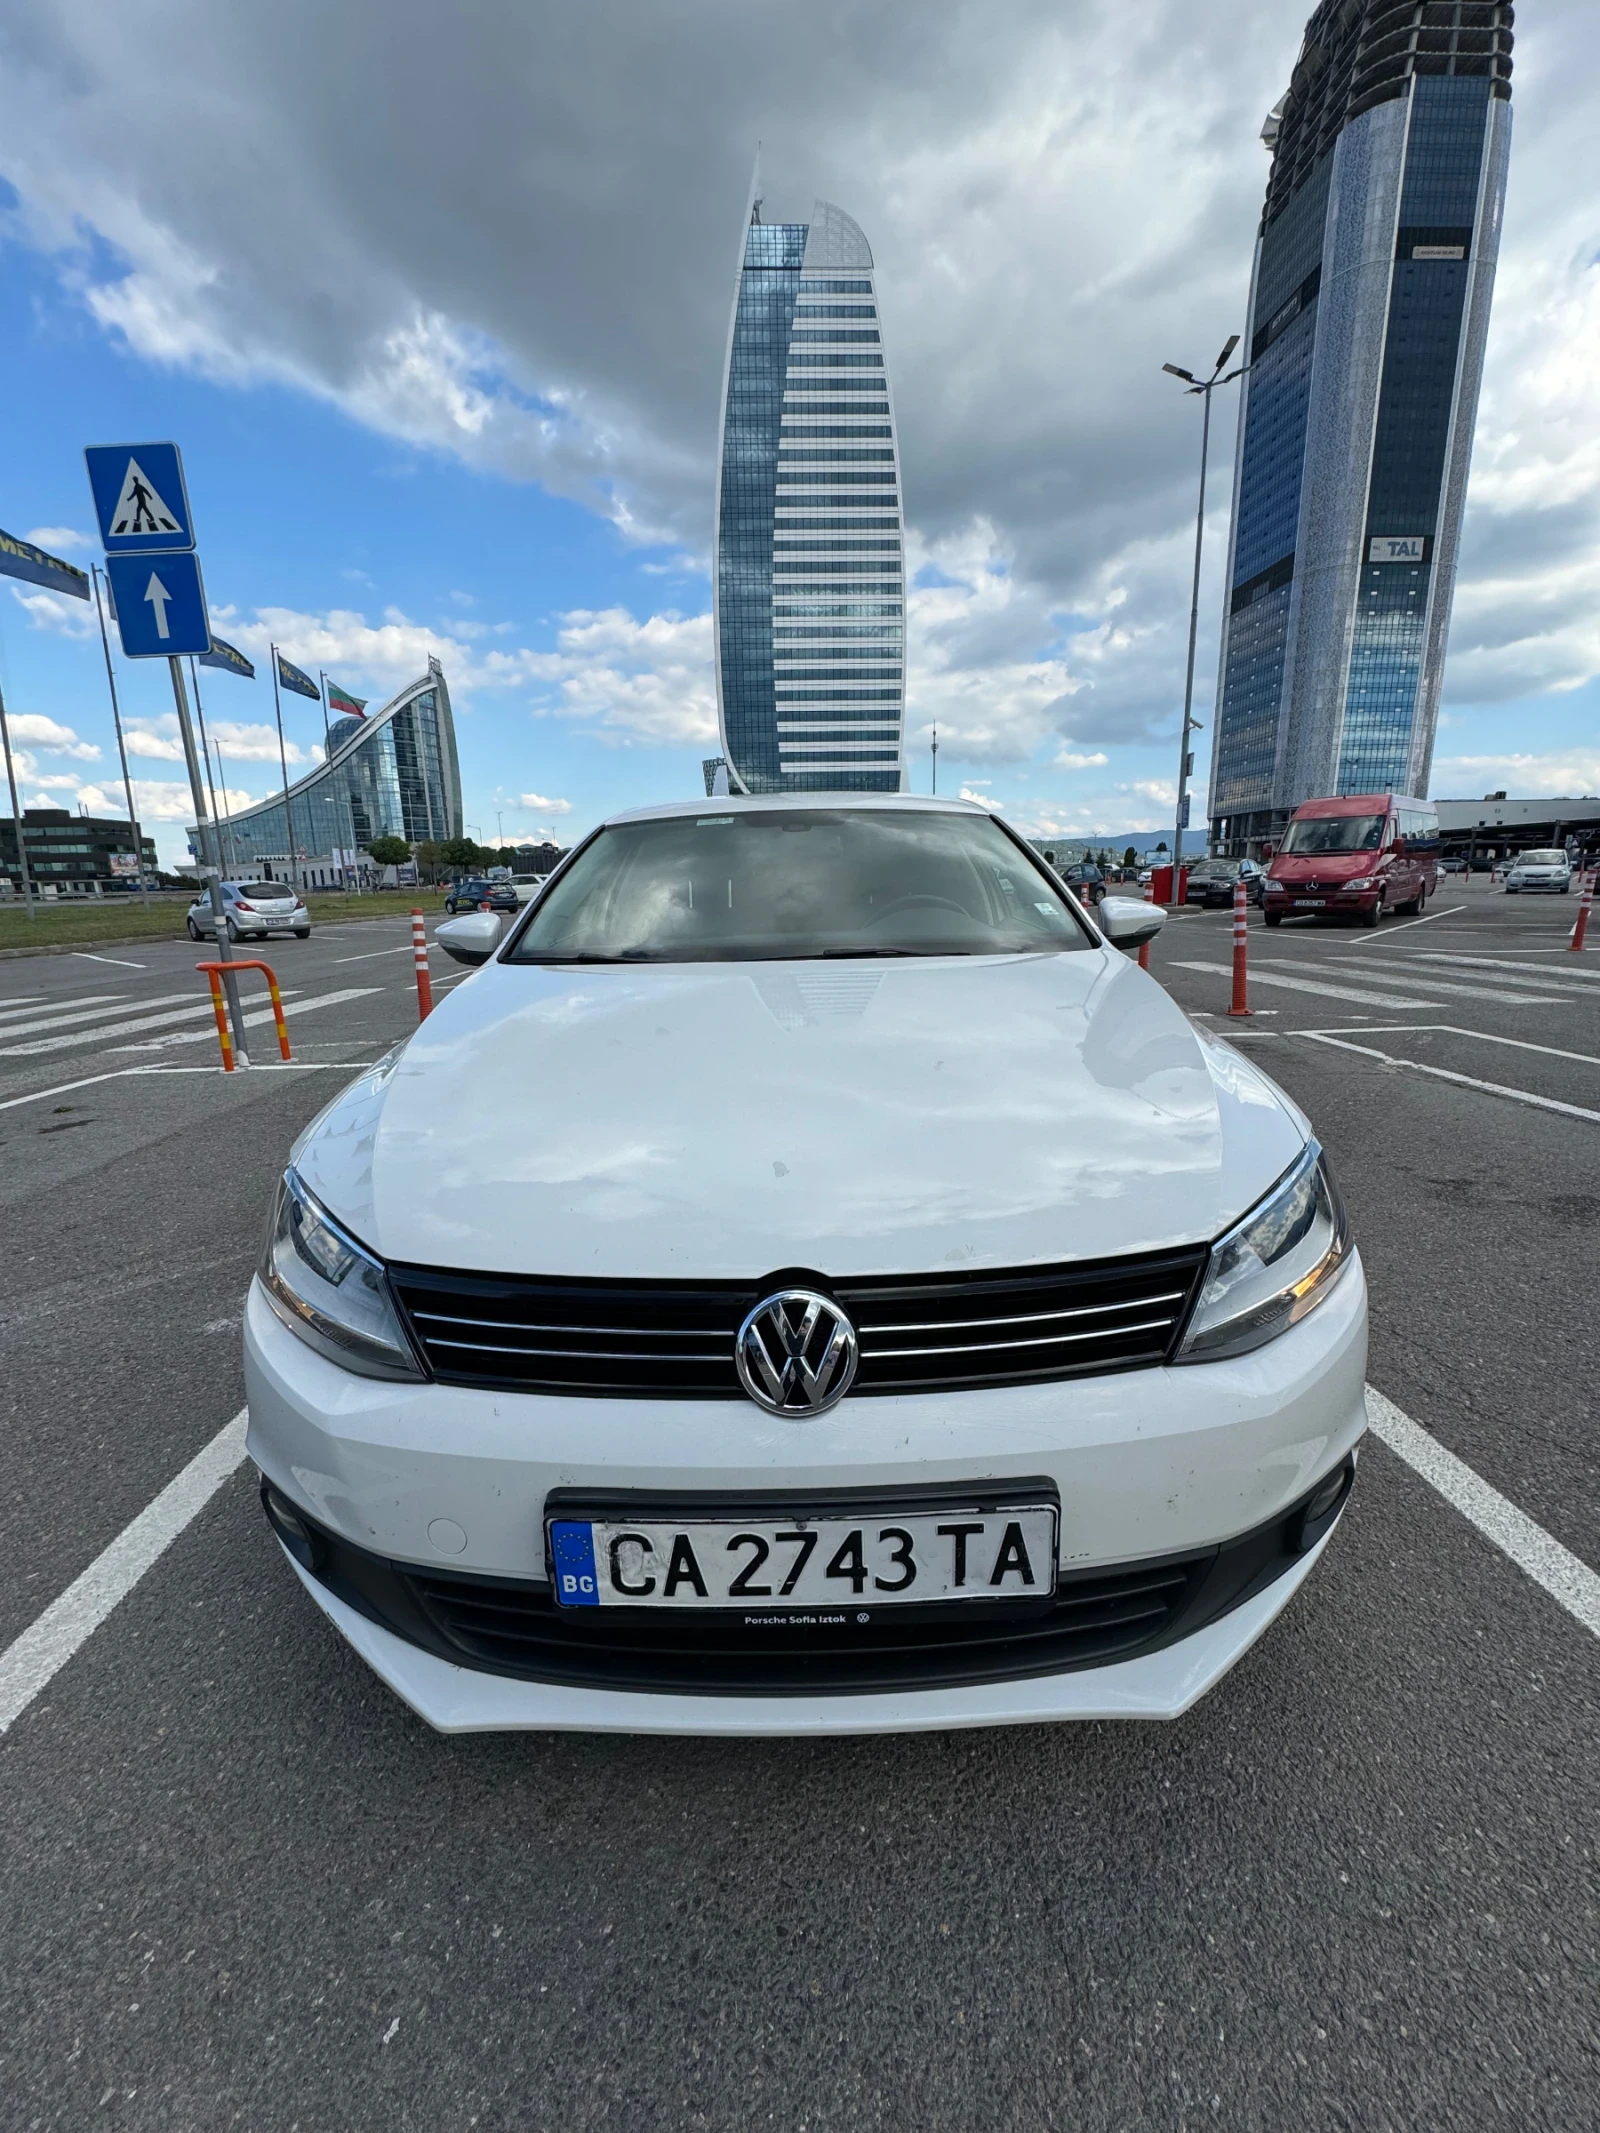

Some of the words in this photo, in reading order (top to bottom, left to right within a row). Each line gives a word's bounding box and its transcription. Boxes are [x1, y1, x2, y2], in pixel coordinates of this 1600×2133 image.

[1387, 541, 1420, 557] TAL
[211, 642, 251, 669] ETR
[609, 1532, 710, 1597] CA
[726, 1527, 918, 1597] 2743
[936, 1521, 1036, 1587] TA
[562, 1574, 595, 1594] BG
[744, 1616, 787, 1625] Porsche
[789, 1615, 817, 1624] Sofia
[818, 1614, 847, 1623] Iztok
